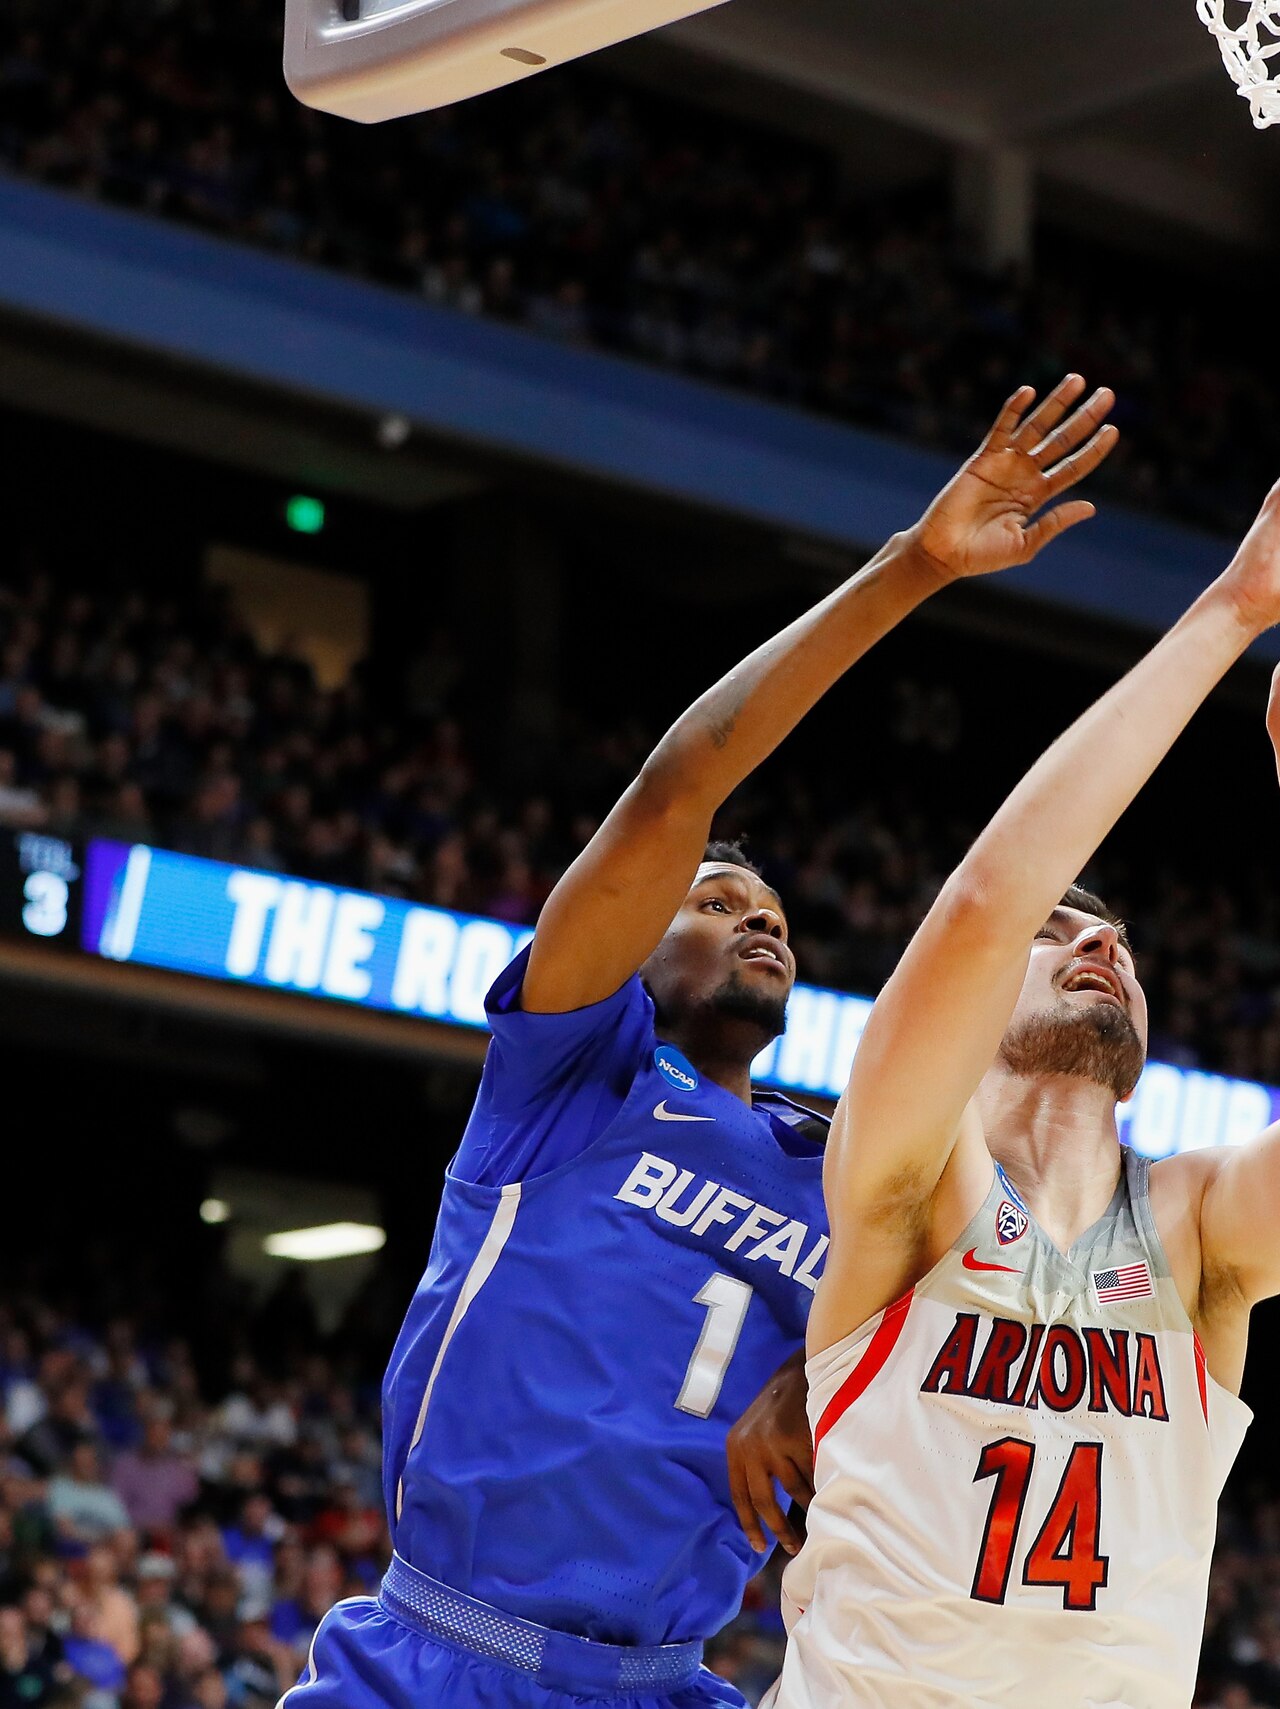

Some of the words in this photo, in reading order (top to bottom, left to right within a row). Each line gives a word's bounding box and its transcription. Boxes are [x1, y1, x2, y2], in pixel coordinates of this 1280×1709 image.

[22, 871, 69, 936] 3
[225, 869, 385, 999] THE
[391, 907, 536, 1025] RO
[1115, 1061, 1271, 1158] OUR
[658, 1058, 696, 1088] NCAA
[673, 1271, 754, 1420] 1
[919, 1312, 1170, 1422] ARIONA
[969, 1435, 1110, 1611] 14
